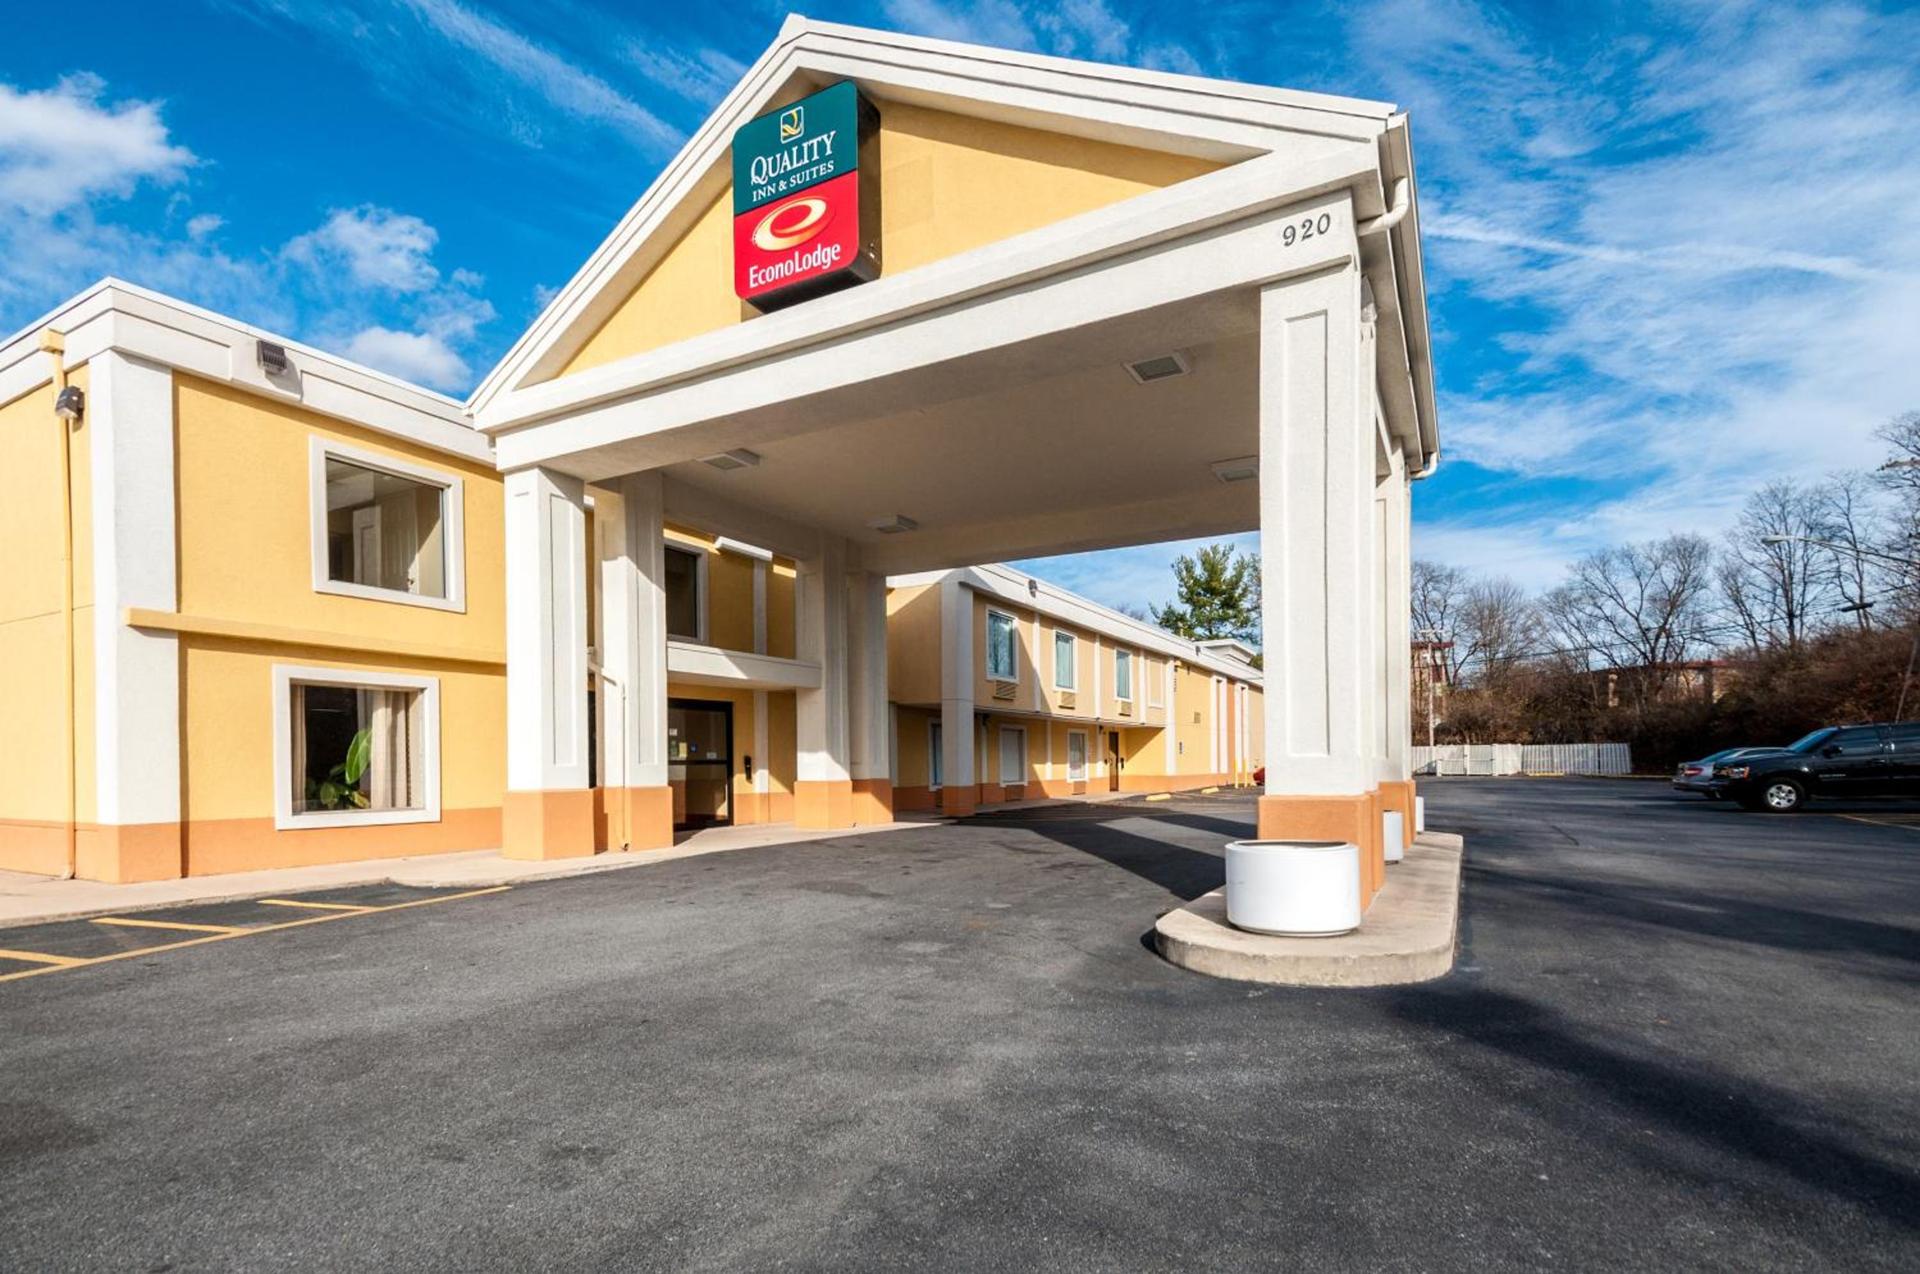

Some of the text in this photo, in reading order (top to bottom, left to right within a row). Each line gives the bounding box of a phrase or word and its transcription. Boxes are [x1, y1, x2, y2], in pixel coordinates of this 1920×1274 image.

[751, 131, 836, 185] QUALITY
[753, 160, 834, 202] INN & SUITES
[1283, 213, 1331, 247] 920
[749, 243, 841, 288] EconoLodge
